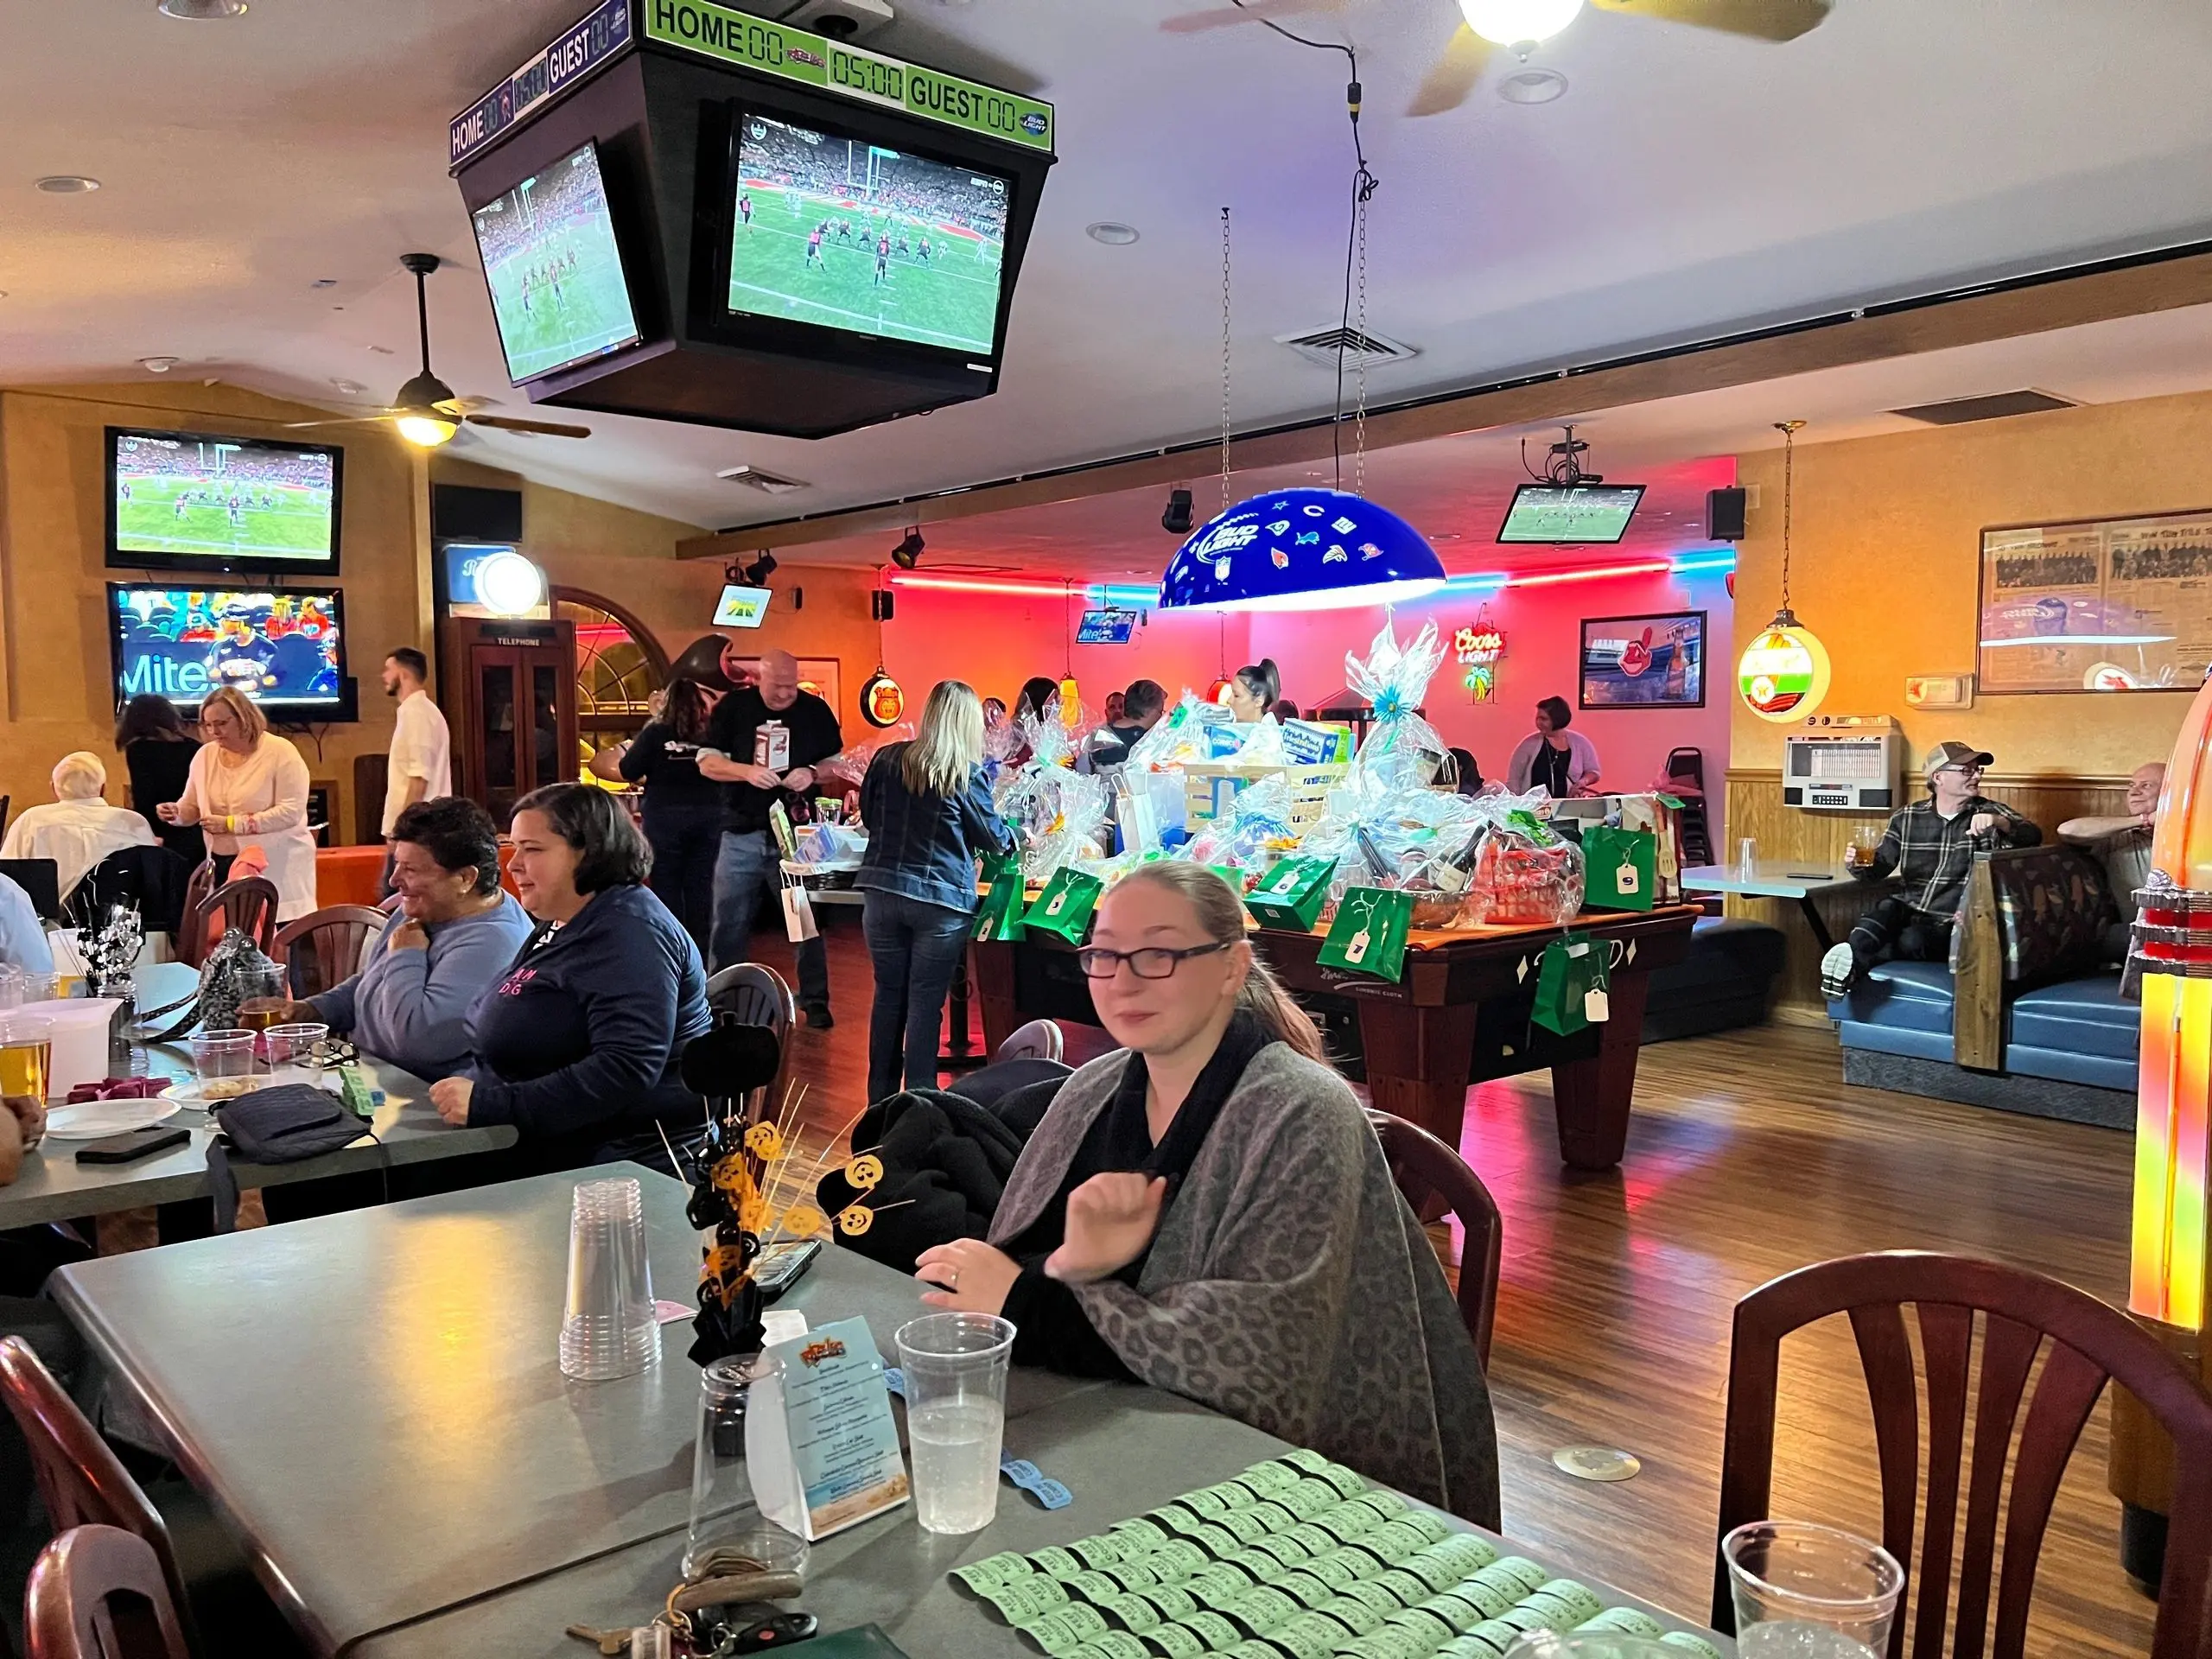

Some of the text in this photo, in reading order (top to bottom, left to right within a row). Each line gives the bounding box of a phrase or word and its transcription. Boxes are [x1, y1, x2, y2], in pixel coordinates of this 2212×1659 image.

[657, 0, 743, 54] HOME
[749, 26, 782, 66] 00
[550, 28, 589, 84] GUEST
[834, 51, 902, 100] 05:00
[911, 76, 983, 121] GUEST
[1022, 121, 1047, 131] LIGHT
[1027, 115, 1045, 124] BUD
[452, 110, 484, 156] HOME
[1213, 524, 1259, 542] BUD
[1202, 535, 1258, 555] LIGHT
[498, 638, 540, 646] TELEPHONE
[1455, 627, 1502, 652] Coors
[1458, 650, 1501, 664] LIGHT
